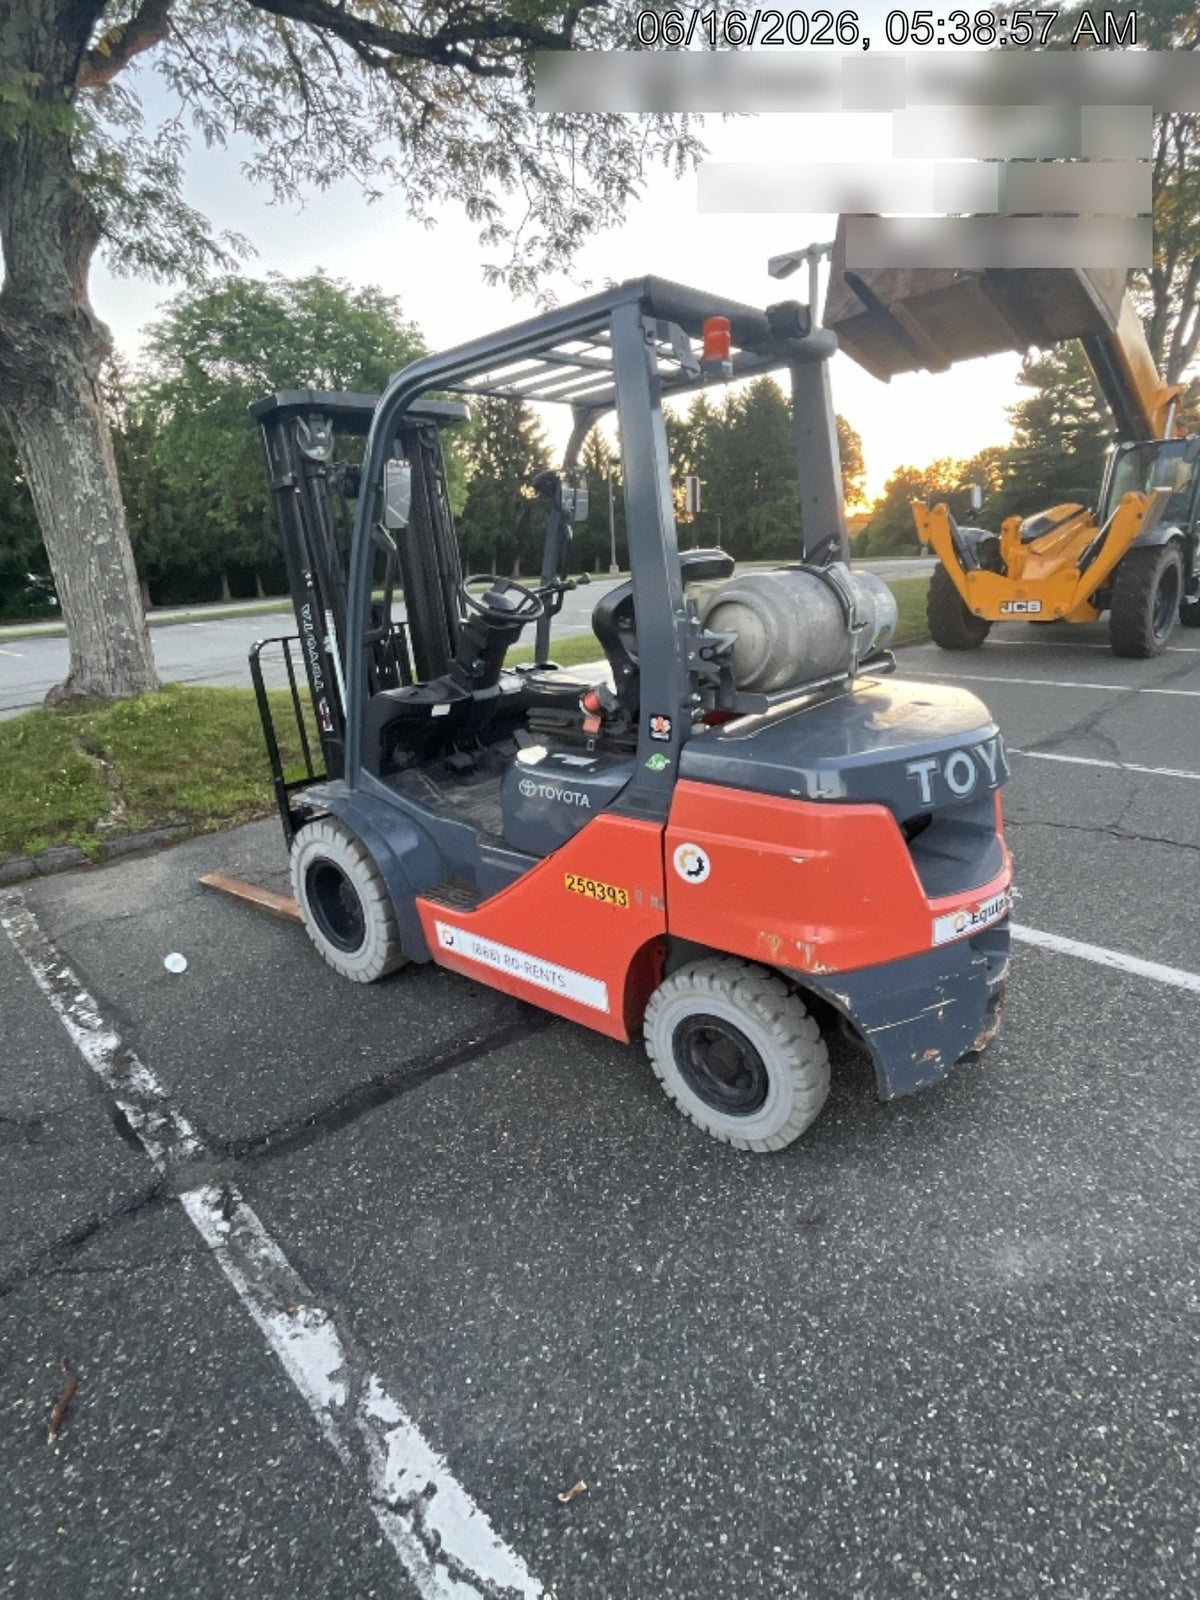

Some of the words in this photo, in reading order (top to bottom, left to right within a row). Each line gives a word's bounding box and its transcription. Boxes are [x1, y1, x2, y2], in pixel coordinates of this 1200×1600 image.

[1000, 600, 1042, 614] JCB
[906, 734, 1011, 807] TOY
[537, 784, 591, 808] TOYOTA
[566, 874, 628, 907] 259393
